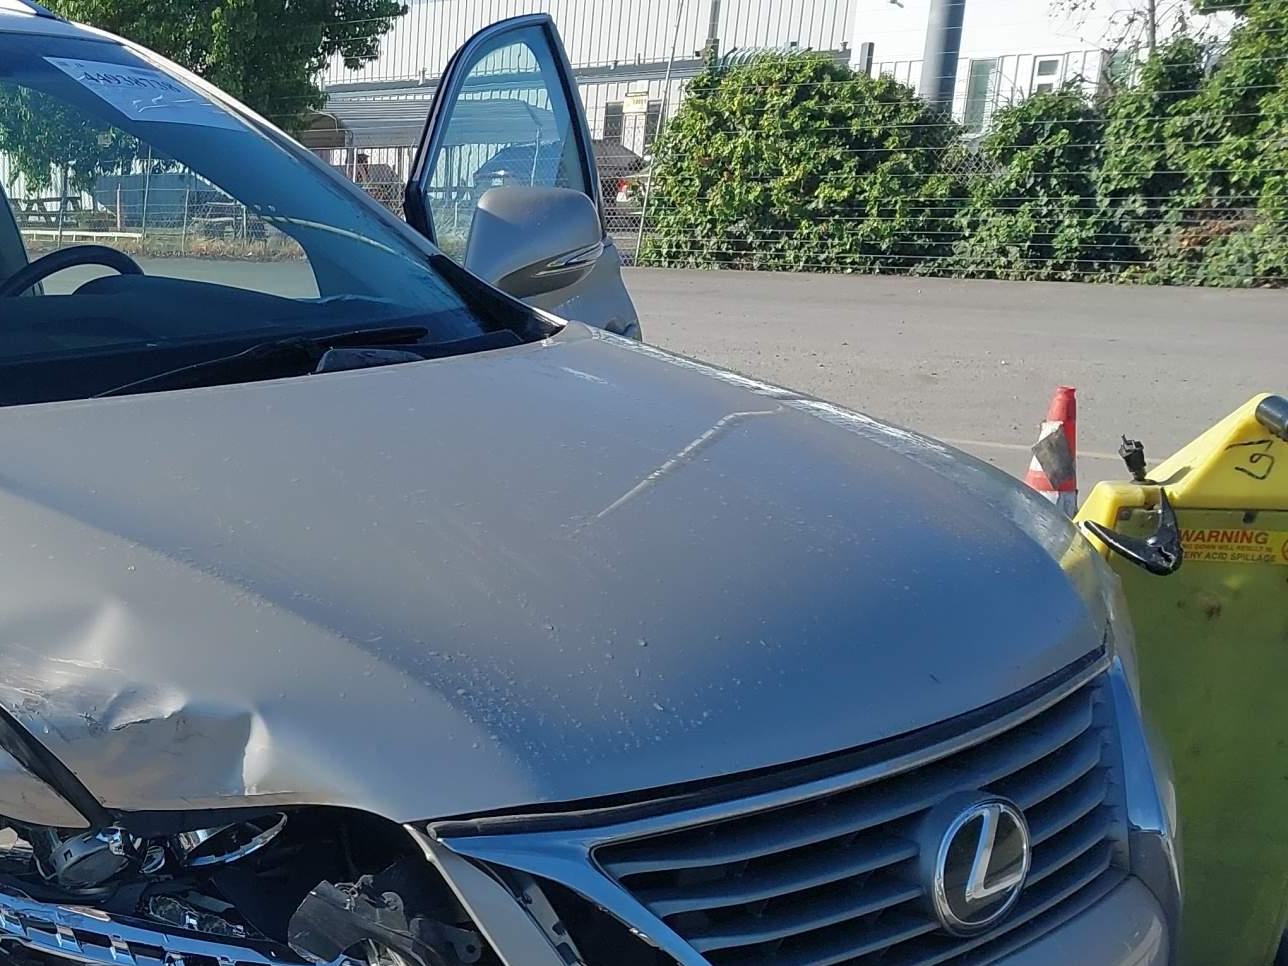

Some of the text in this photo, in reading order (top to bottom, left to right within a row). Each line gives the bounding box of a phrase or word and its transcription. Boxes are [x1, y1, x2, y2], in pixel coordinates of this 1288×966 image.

[1179, 530, 1269, 545] WARNING
[1204, 552, 1229, 561] ACID
[1231, 553, 1277, 562] SPILLAGE
